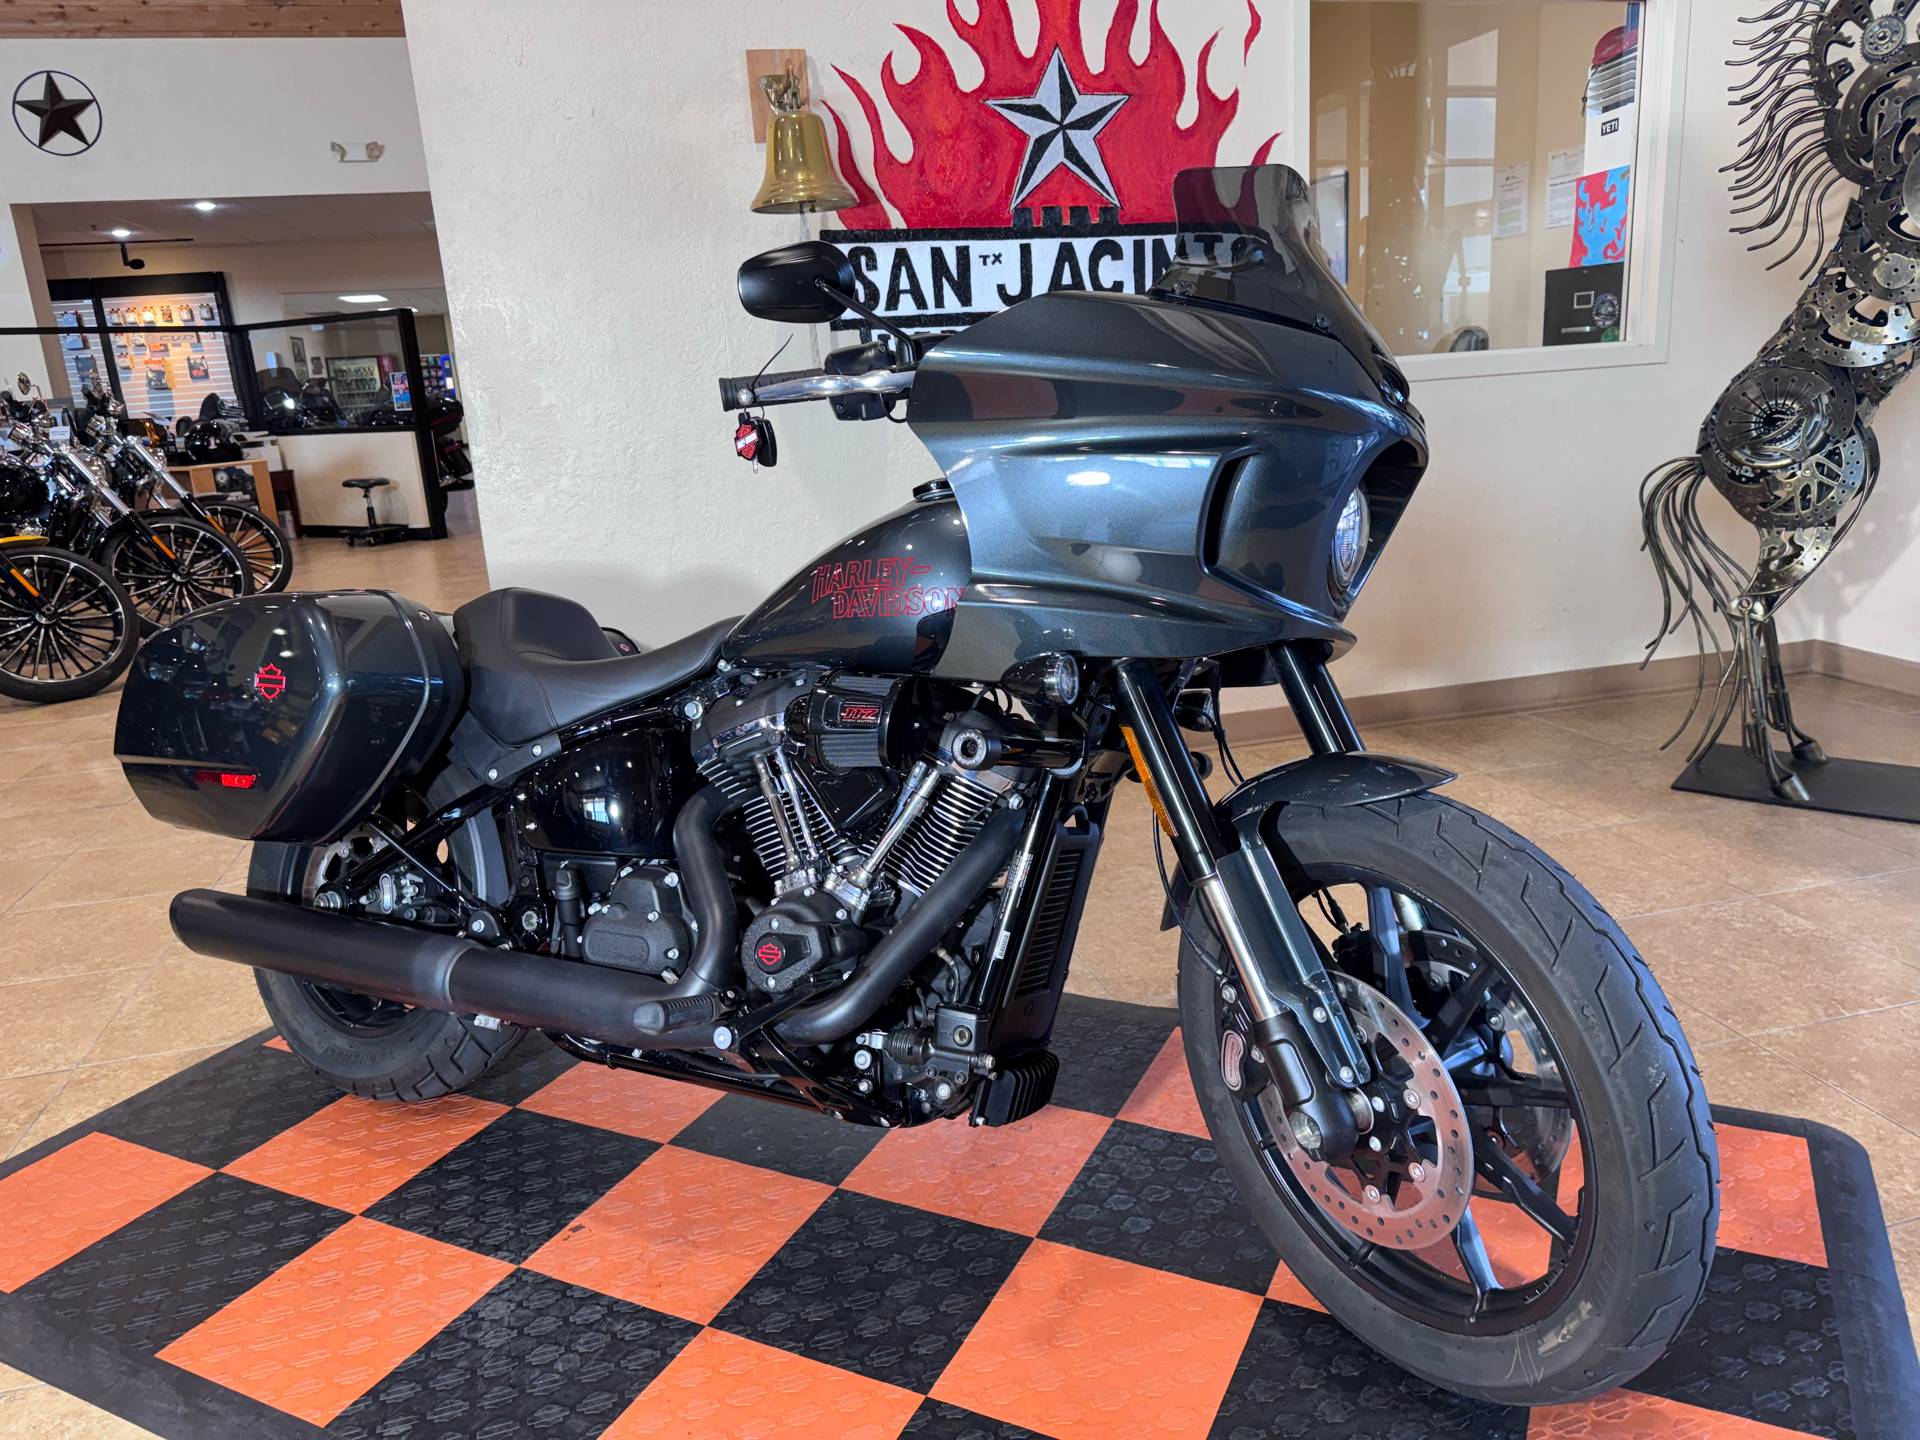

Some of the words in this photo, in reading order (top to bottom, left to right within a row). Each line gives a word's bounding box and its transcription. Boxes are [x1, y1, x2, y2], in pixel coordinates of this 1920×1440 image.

[1602, 120, 1618, 134] YETI
[850, 246, 972, 312] SAN
[979, 252, 1003, 266] TX
[811, 557, 931, 604] HARLEY-
[960, 732, 983, 748] HARLEY
